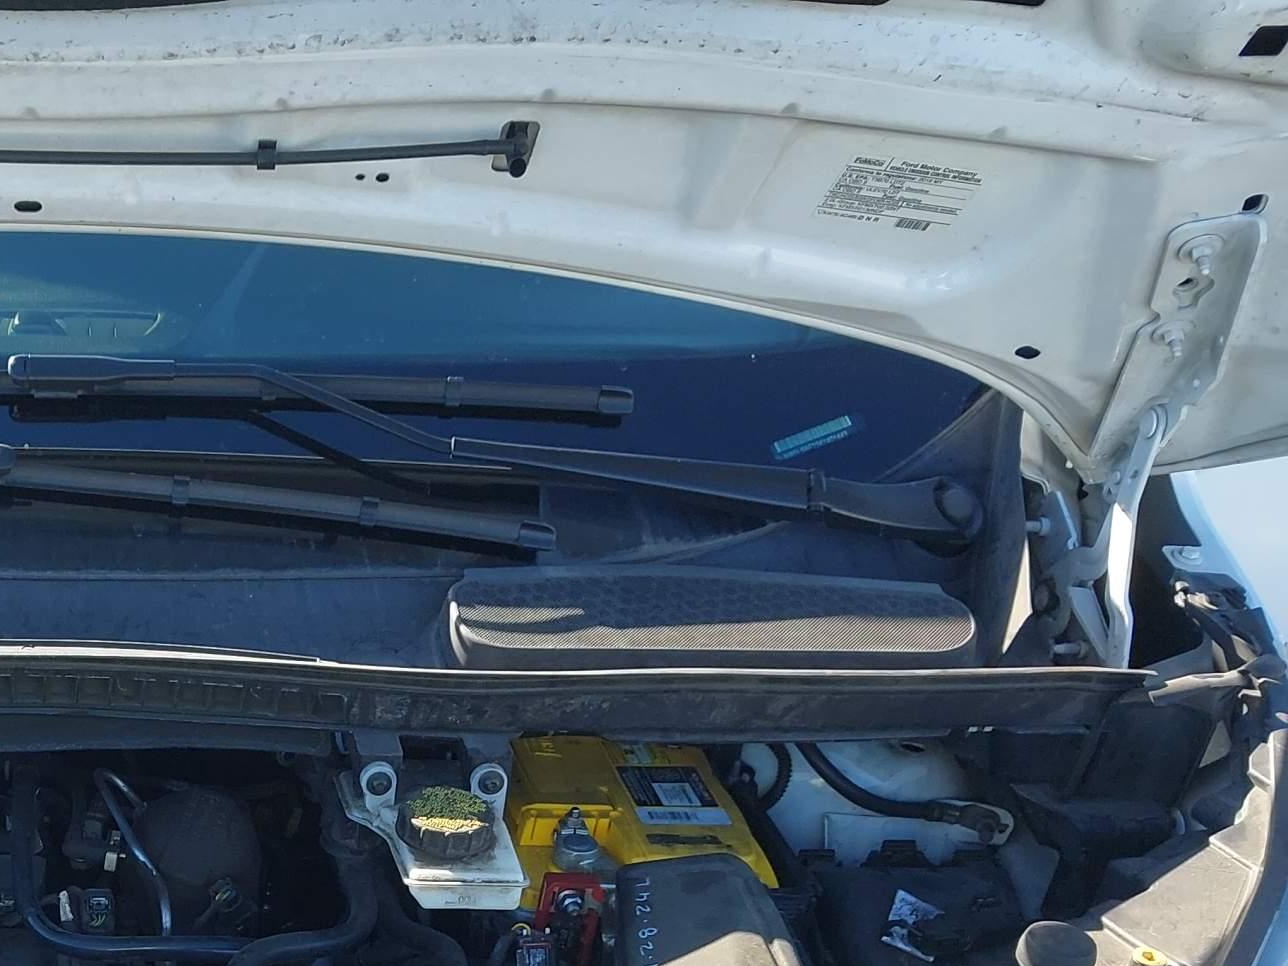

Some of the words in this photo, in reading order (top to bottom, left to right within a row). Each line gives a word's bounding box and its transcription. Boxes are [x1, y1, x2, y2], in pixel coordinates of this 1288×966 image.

[854, 157, 886, 167] FoMoCo
[901, 160, 920, 169] Ford
[920, 163, 942, 172] Motor
[942, 167, 979, 178] Company
